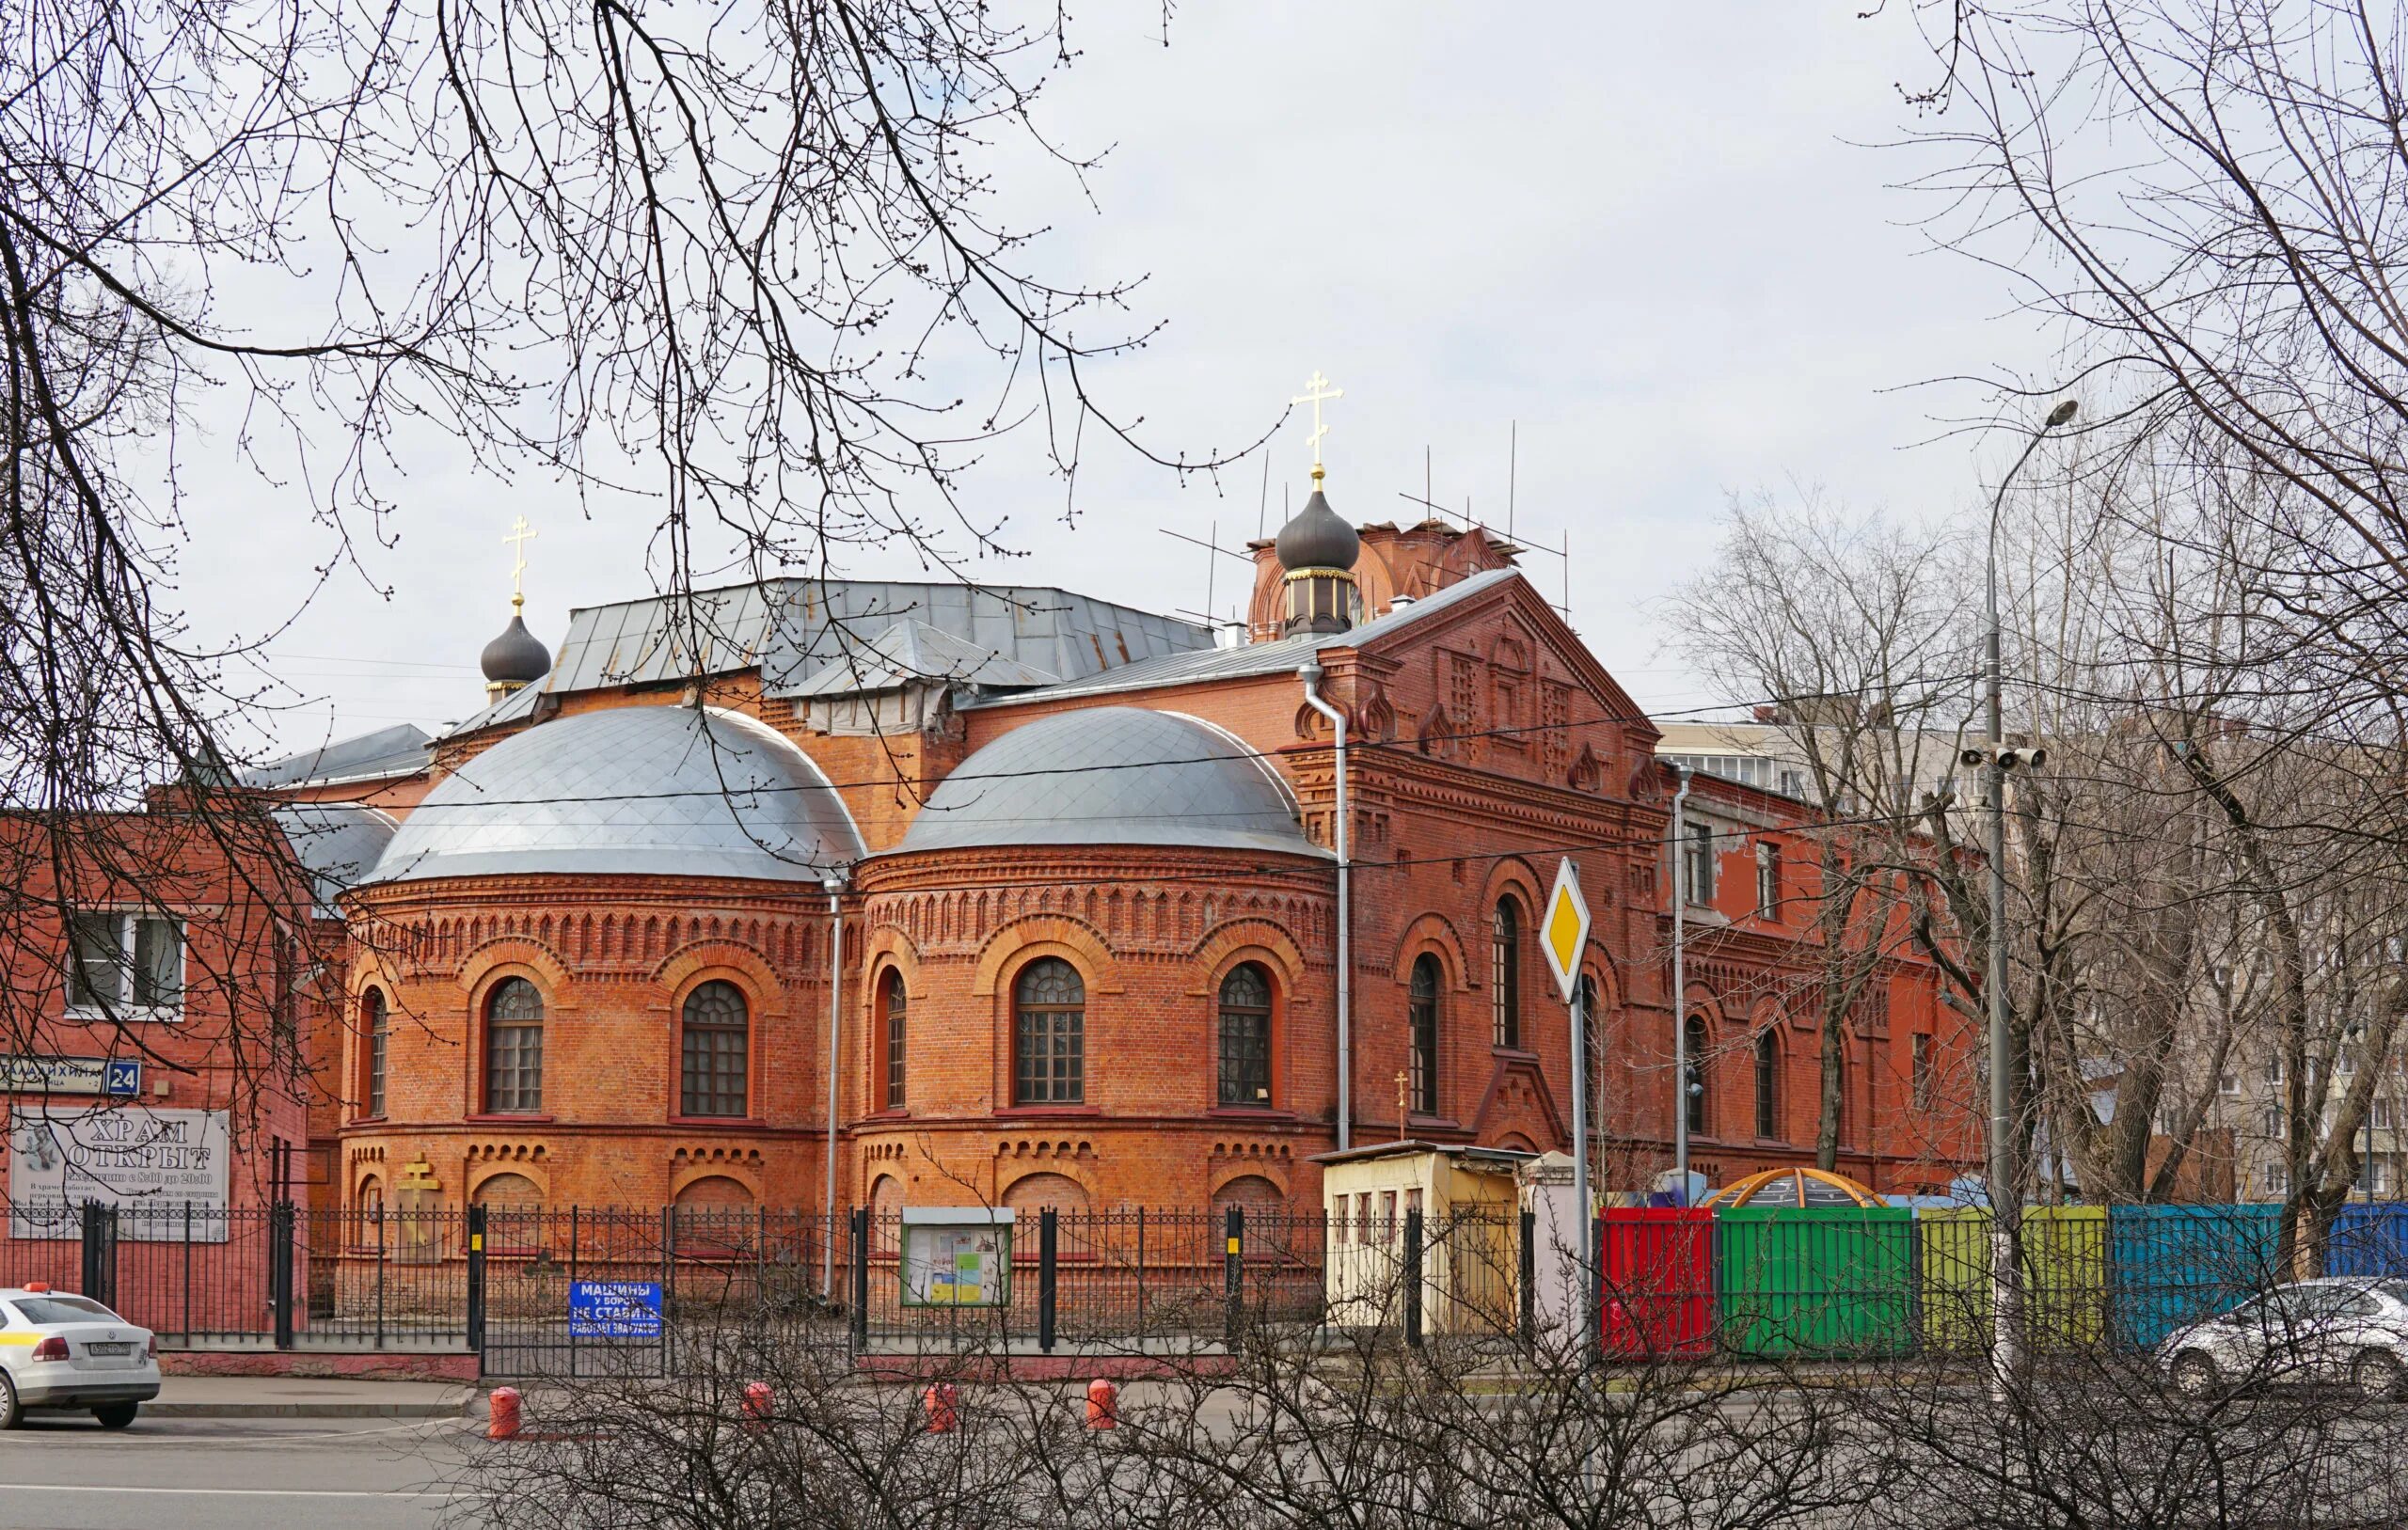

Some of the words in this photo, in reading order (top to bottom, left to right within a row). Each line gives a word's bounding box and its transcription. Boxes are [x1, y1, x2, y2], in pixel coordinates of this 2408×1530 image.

[111, 1068, 135, 1088] 24
[91, 1118, 188, 1144] ХРАМ
[68, 1144, 211, 1170] ОТКРЫТ
[181, 1174, 213, 1185] 20:00
[581, 1285, 650, 1296] МАШИНЫ
[573, 1307, 591, 1318] НЕ
[595, 1307, 657, 1318] СТАВИТЬ
